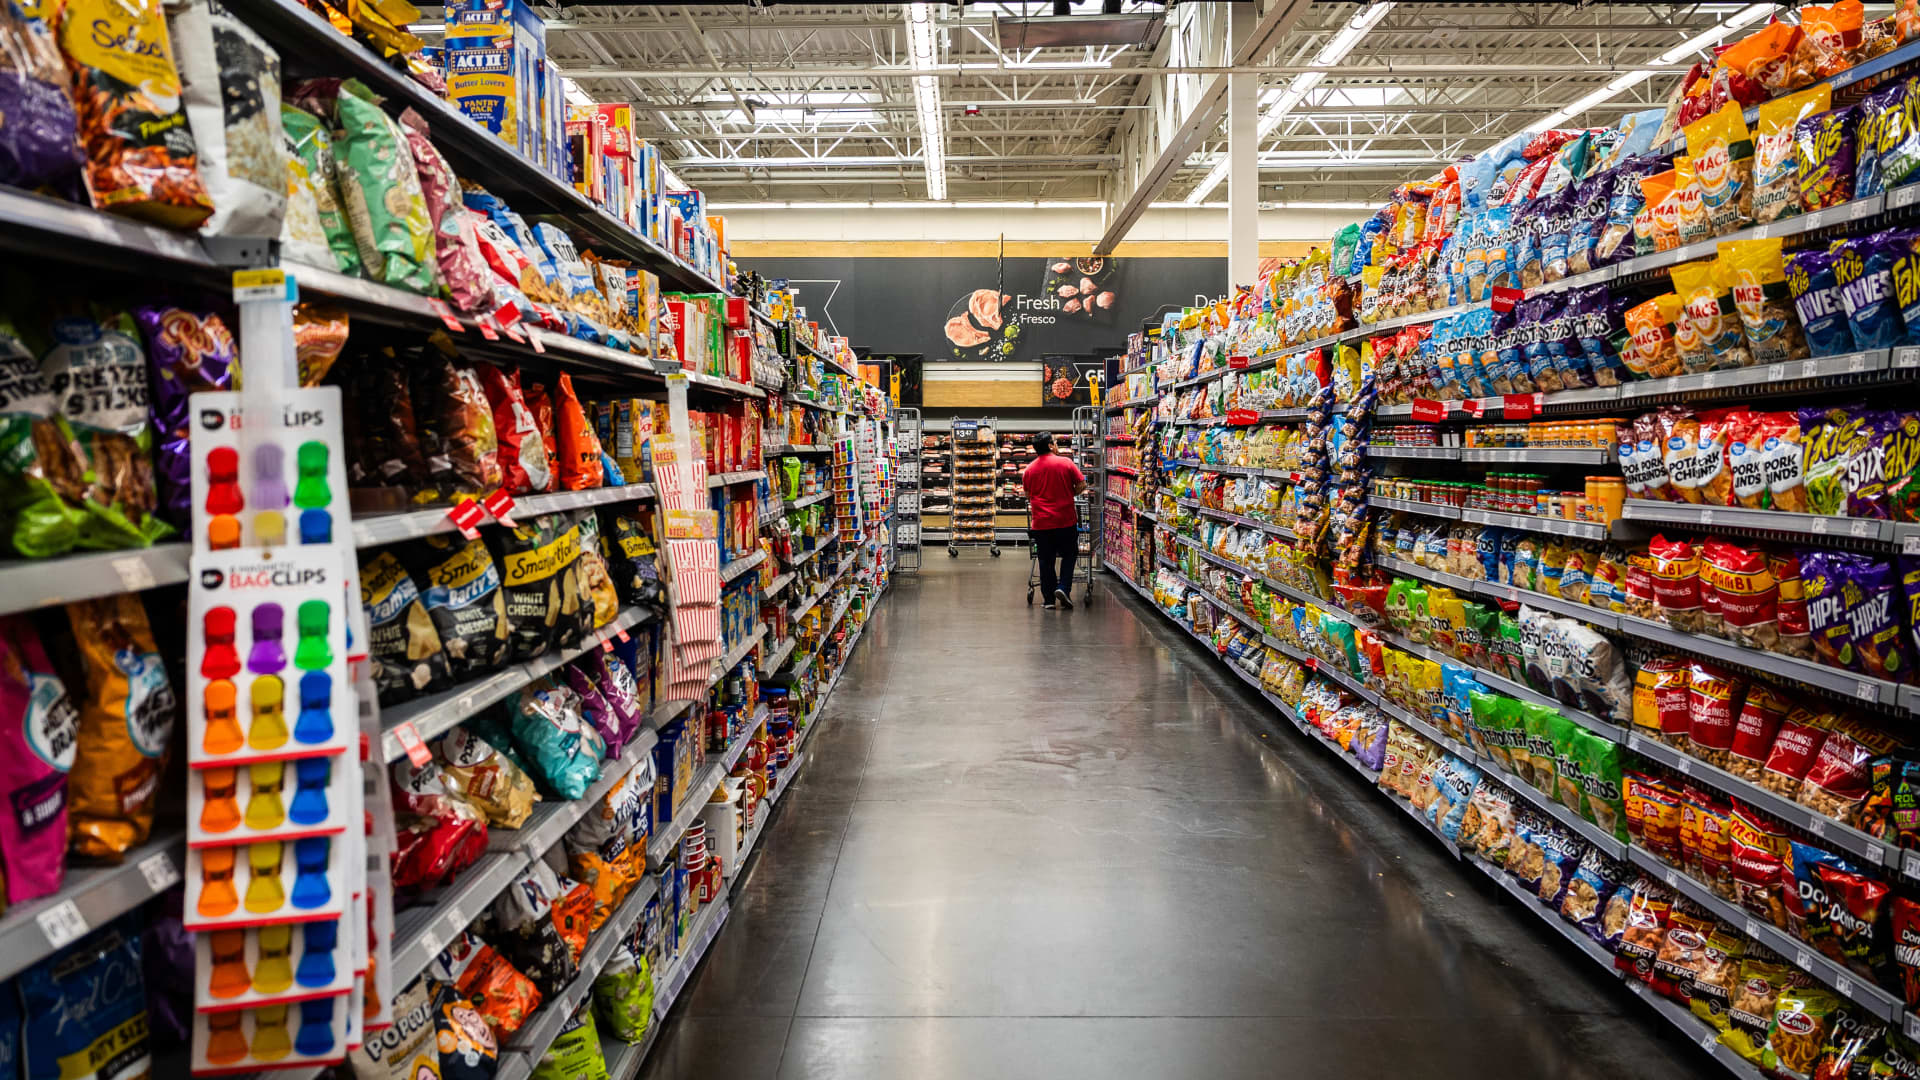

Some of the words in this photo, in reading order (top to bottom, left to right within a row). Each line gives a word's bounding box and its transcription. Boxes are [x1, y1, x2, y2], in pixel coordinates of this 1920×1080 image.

[457, 55, 484, 68] ACT
[455, 77, 478, 90] Butter
[480, 76, 505, 87] Lovers
[1016, 294, 1060, 310] Fresh
[1020, 313, 1056, 324] Fresco
[1414, 406, 1439, 415] Rollback
[1505, 402, 1529, 411] Rollback
[1764, 454, 1798, 470] PORK
[1733, 463, 1760, 476] PORK
[512, 592, 544, 604] WHITE
[1830, 902, 1874, 940] Doritos
[1791, 1018, 1811, 1032] ONLY
